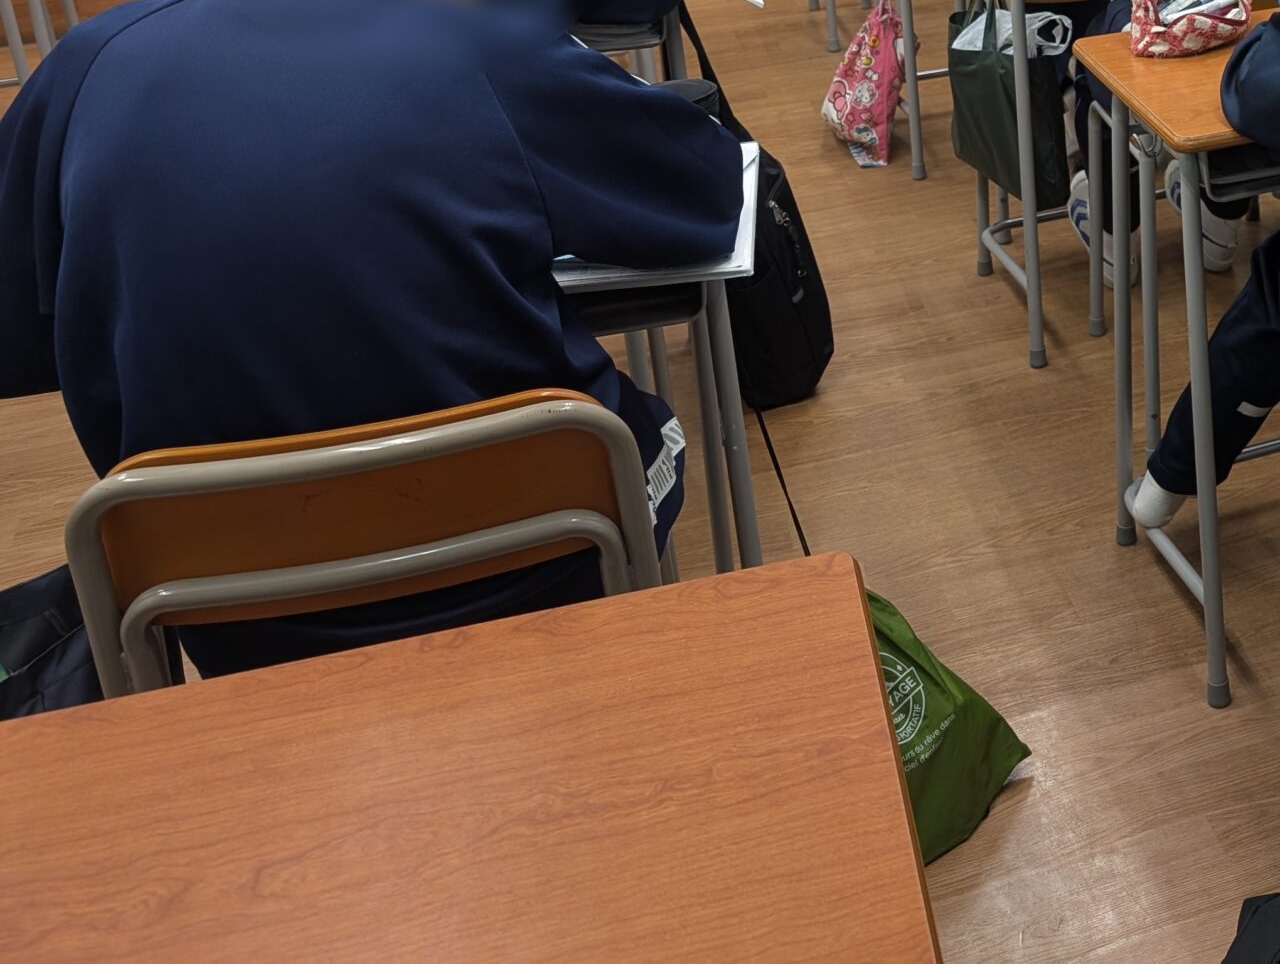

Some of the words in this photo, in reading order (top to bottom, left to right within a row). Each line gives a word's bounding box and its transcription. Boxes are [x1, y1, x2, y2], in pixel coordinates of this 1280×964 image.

[888, 676, 917, 707] YAGE
[899, 703, 922, 739] PORTATIF
[914, 744, 925, 754] du
[924, 729, 941, 746] rêve
[940, 713, 957, 730] dans
[904, 758, 920, 772] ciel
